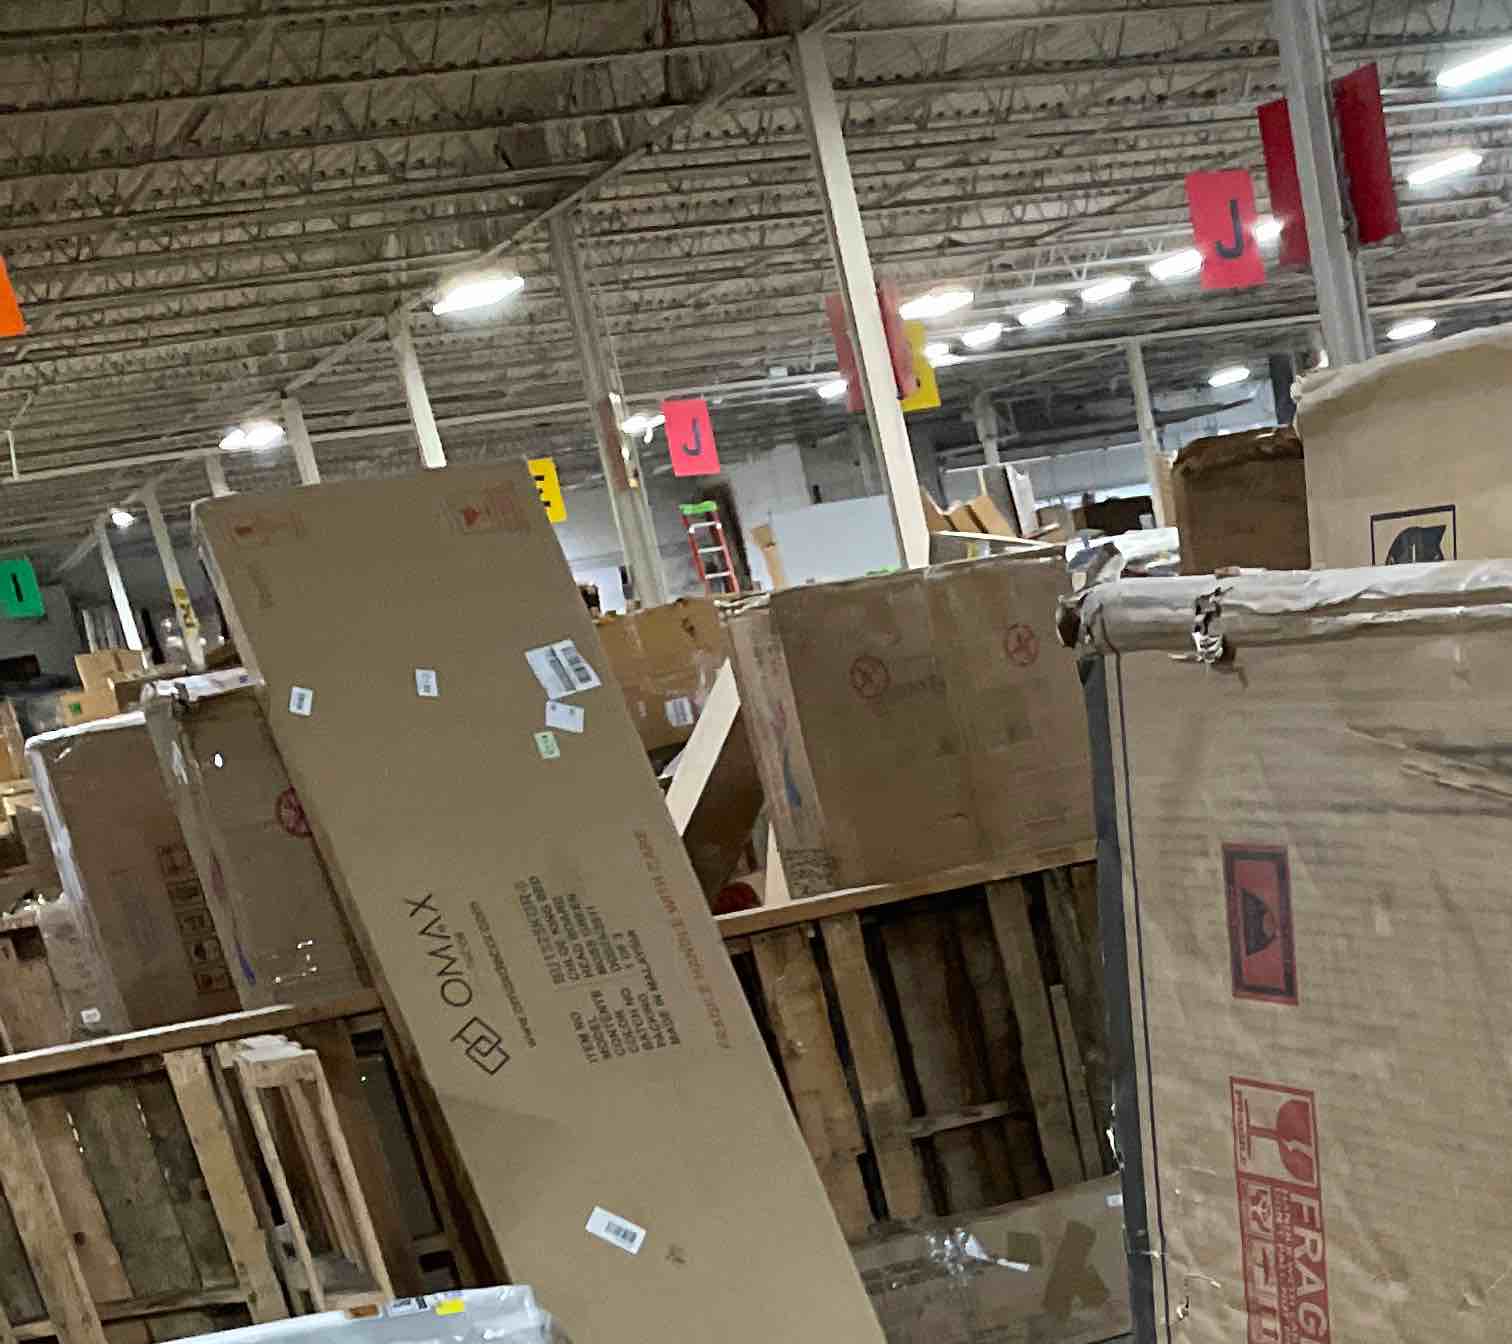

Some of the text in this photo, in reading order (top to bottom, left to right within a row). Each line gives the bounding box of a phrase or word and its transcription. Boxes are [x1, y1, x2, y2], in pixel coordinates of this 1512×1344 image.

[1215, 199, 1244, 260] J
[681, 417, 702, 456] J
[402, 893, 472, 1007] OMAX
